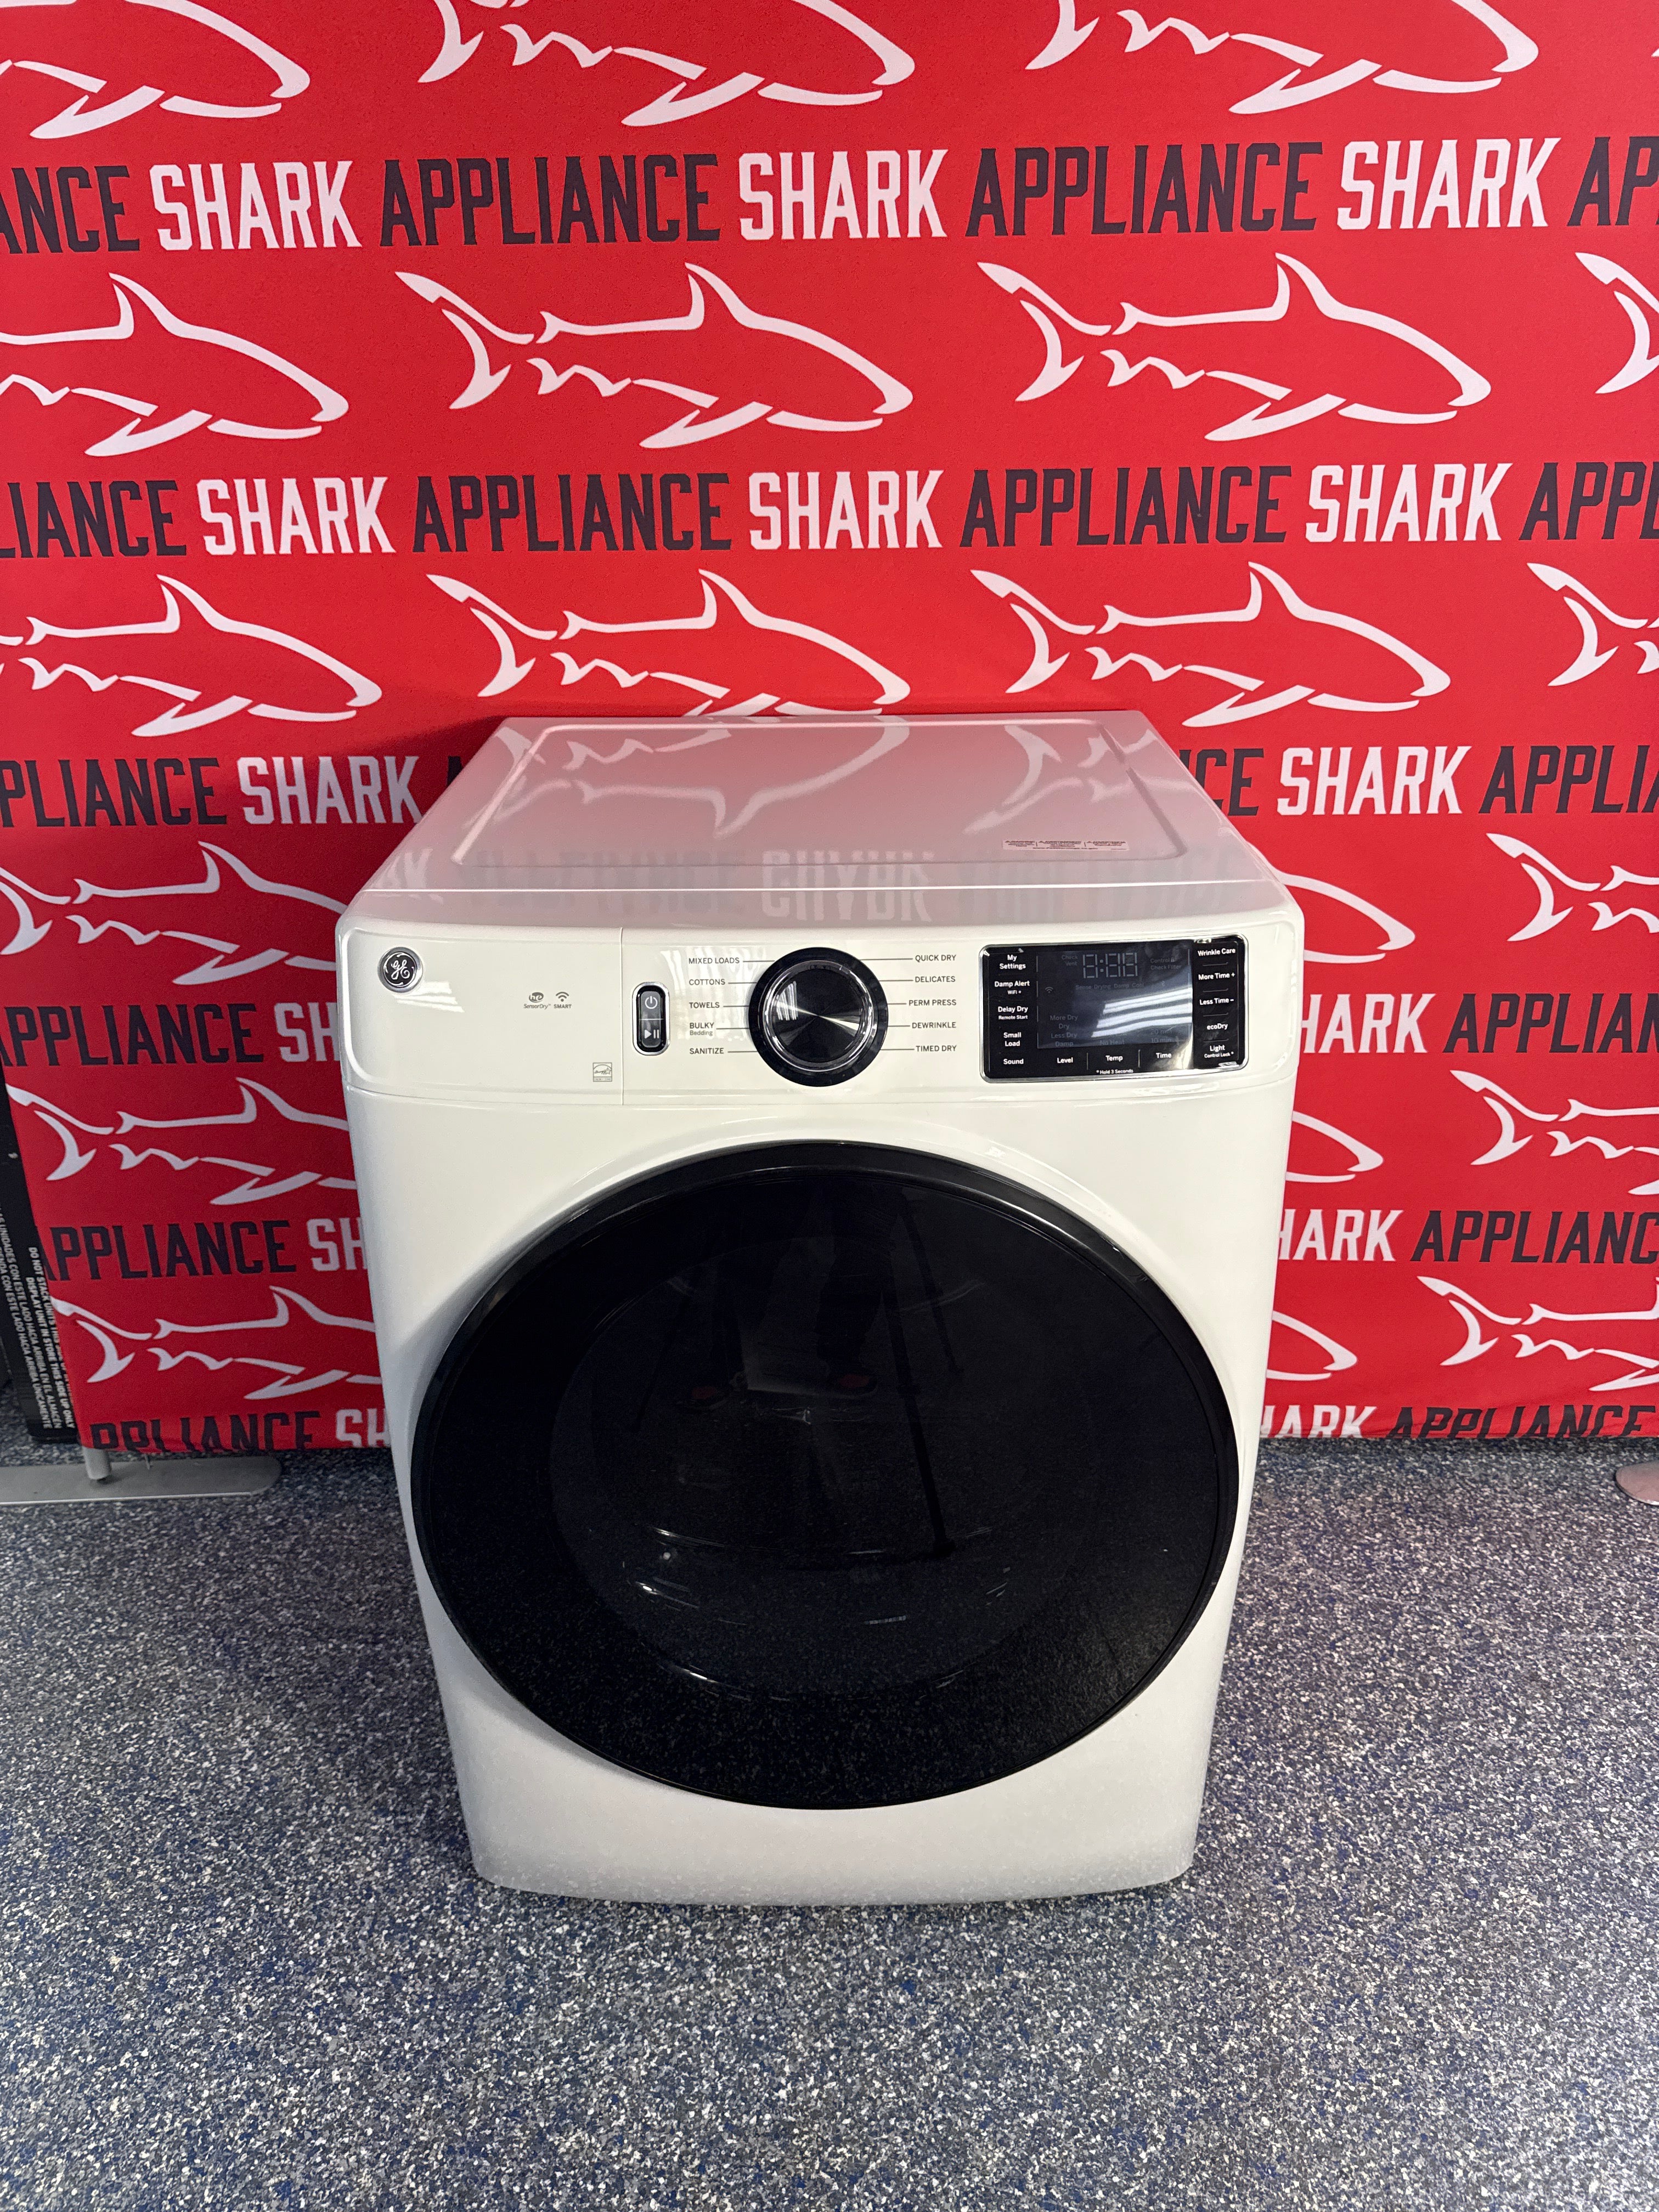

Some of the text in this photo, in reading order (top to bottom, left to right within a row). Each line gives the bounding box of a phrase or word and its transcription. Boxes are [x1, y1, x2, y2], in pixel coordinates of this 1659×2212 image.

[0, 137, 1659, 253] NCE SHARK APPLIANCE SHARK APPLIANCE SHARK AP
[0, 481, 187, 558] IANCE
[196, 477, 396, 555] SHARK
[413, 473, 732, 552] APPLIANCE
[749, 470, 943, 550] SHARK
[960, 466, 1291, 547] APPLIANCE
[1305, 462, 1513, 543] SHARK
[0, 758, 227, 827] PLIANCE
[236, 756, 424, 825] SHARK
[1277, 746, 1471, 816] SHARK
[29, 1246, 40, 1259] DO
[8, 1264, 21, 1280] CON
[32, 1259, 44, 1276] NOT
[1, 1275, 13, 1291] CON
[13, 1282, 27, 1301] ESTE
[36, 1277, 50, 1302] STACK
[5, 1292, 19, 1312] ESTE
[26, 1277, 42, 1310] DISPLAY
[19, 1301, 33, 1322] LADO
[35, 1310, 48, 1328] UNIT
[11, 1312, 25, 1333] LADO
[25, 1323, 40, 1345] HACIA
[18, 1333, 32, 1356] HACIA
[43, 1338, 58, 1362] STORE
[50, 1362, 62, 1380] THIS
[55, 1380, 67, 1397] SIDE
[60, 1398, 70, 1409] UP
[63, 1409, 75, 1429] ONLY
